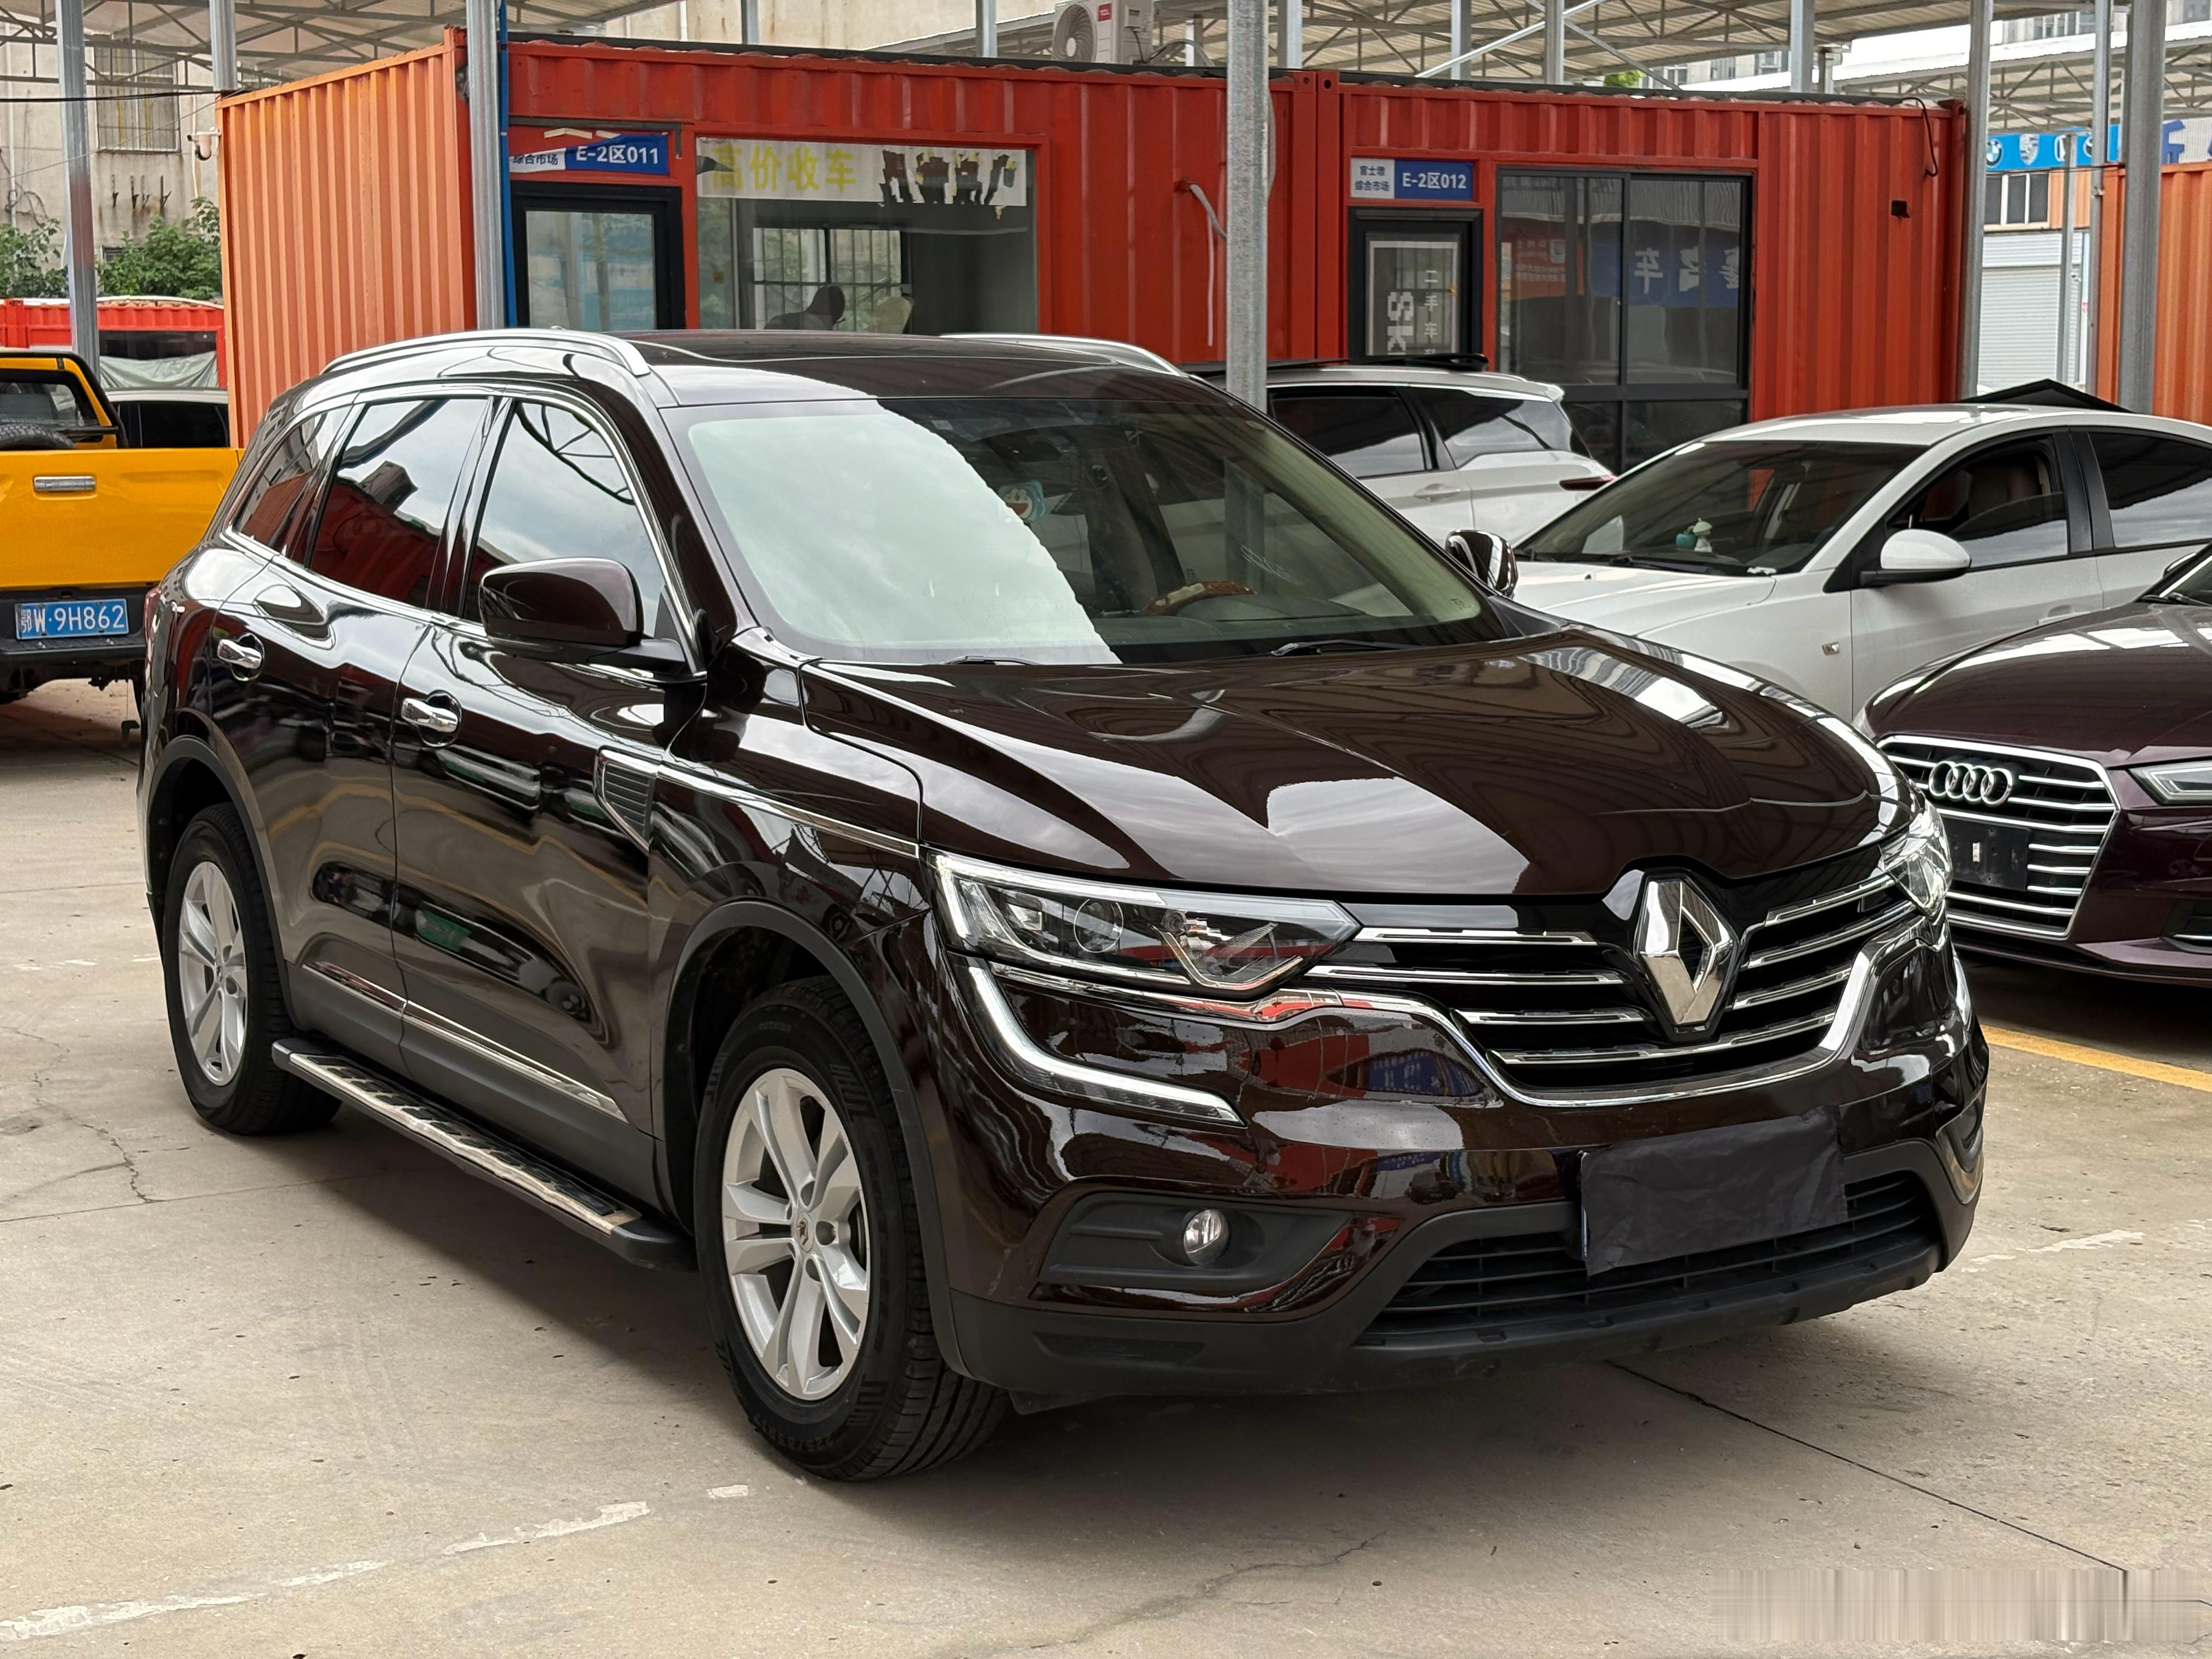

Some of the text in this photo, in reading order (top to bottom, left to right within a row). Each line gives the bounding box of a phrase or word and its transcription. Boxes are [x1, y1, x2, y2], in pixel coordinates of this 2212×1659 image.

[576, 145, 658, 164] E-2区011
[711, 143, 856, 193] 高价收车
[1402, 172, 1467, 189] E-2区012
